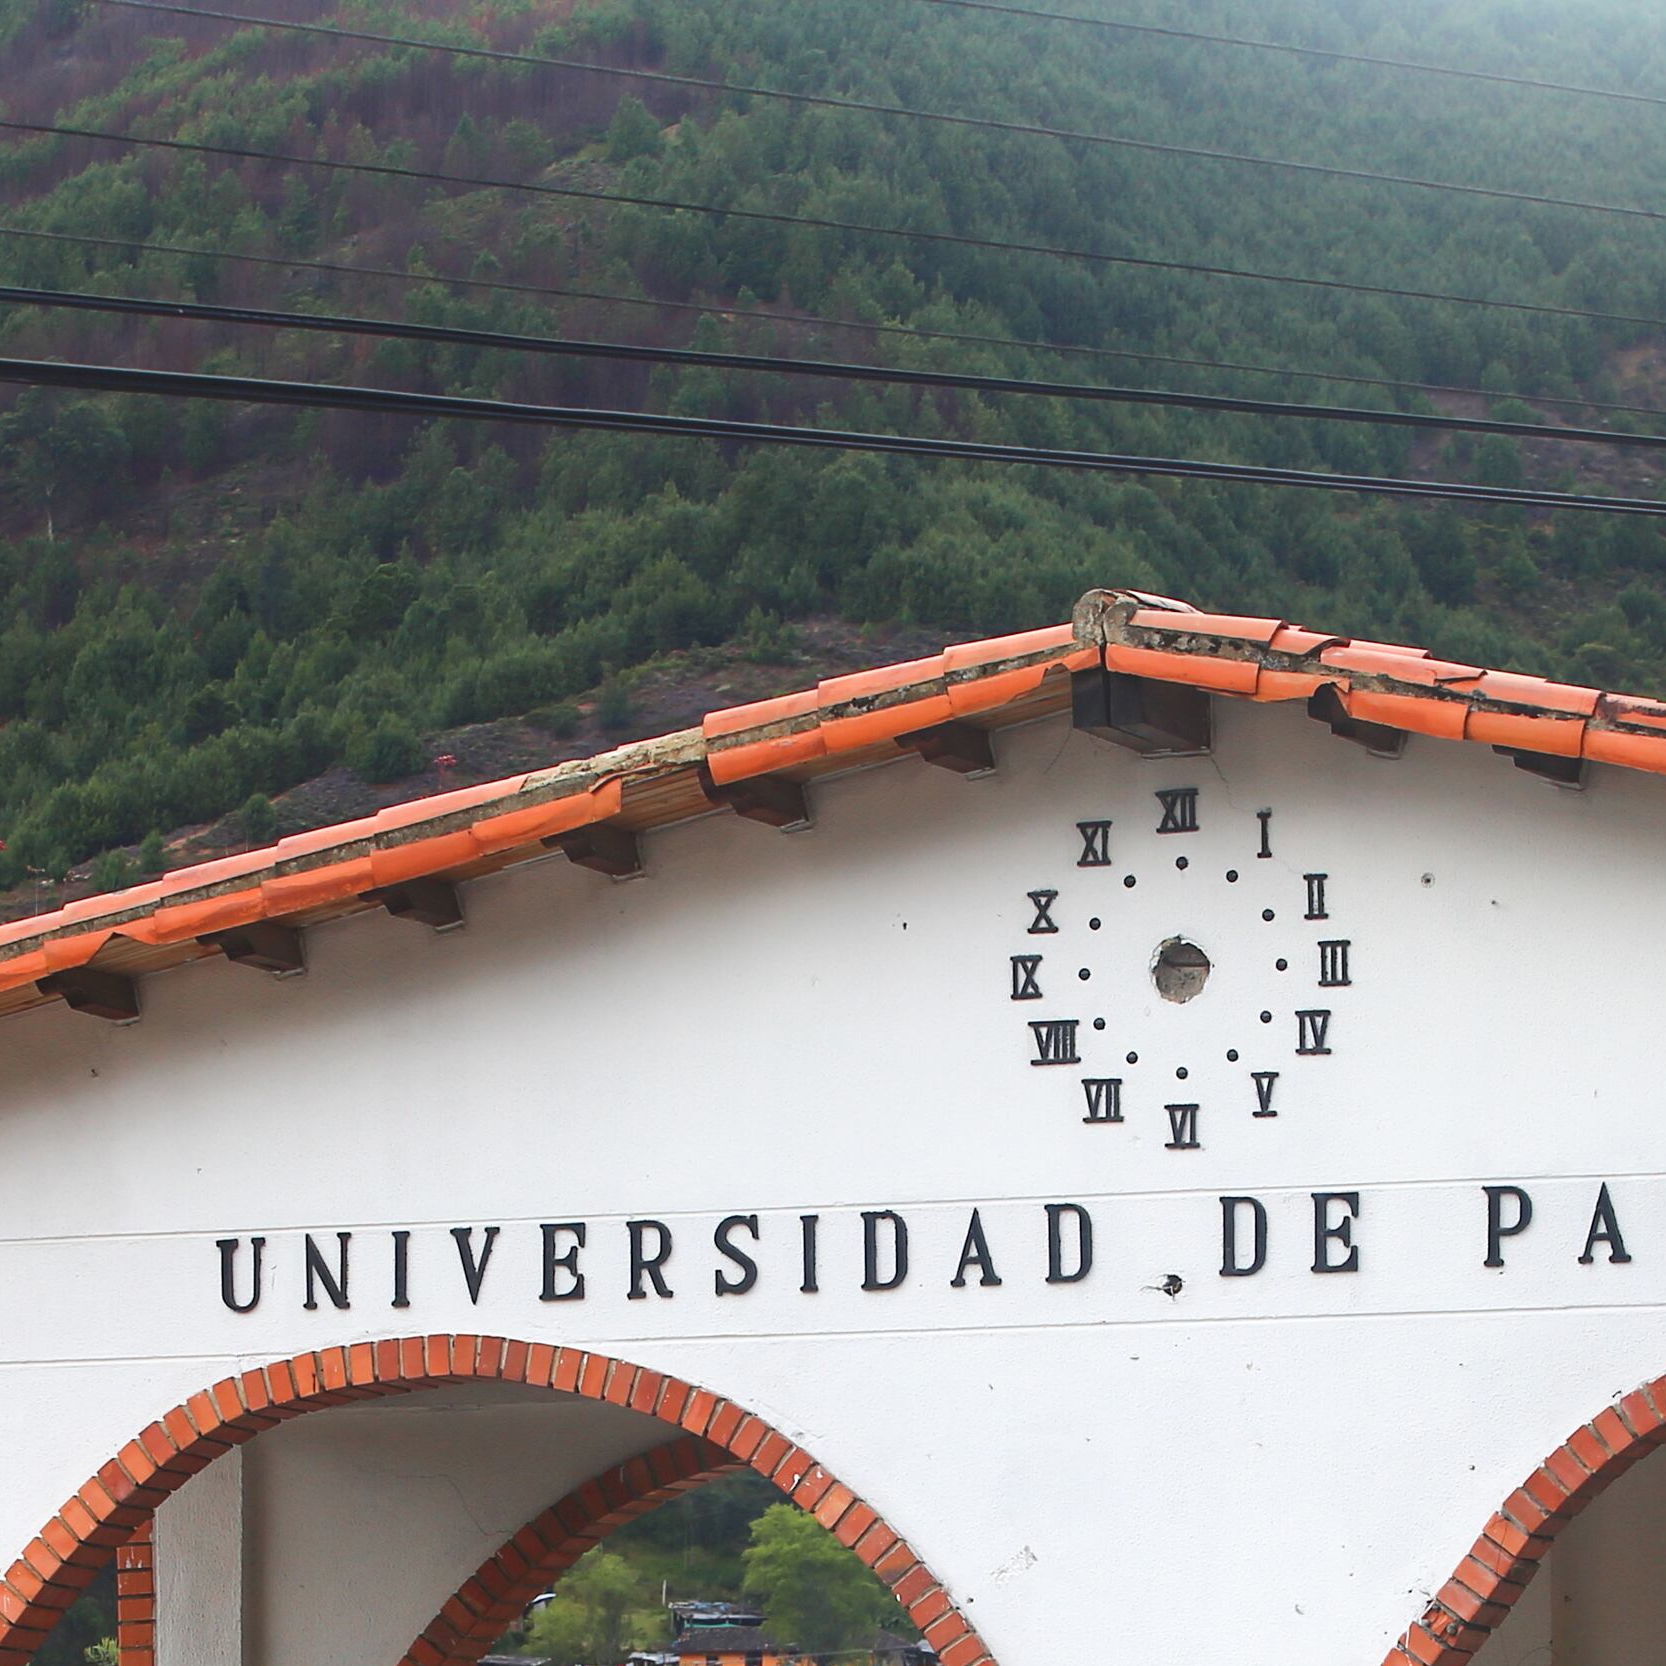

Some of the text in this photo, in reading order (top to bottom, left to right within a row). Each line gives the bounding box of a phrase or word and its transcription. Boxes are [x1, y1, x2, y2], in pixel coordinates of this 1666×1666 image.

[1154, 787, 1200, 834] XII
[1257, 807, 1272, 859] I
[1076, 820, 1113, 867] XI
[1026, 889, 1059, 934] X
[1302, 873, 1329, 920] II
[1010, 954, 1043, 1001] IX
[1317, 939, 1352, 987] III
[1027, 1019, 1082, 1066] VIII
[1294, 1009, 1332, 1055] IV
[1080, 1078, 1125, 1124] VII
[1250, 1071, 1280, 1118] V
[1163, 1103, 1201, 1150] VI
[215, 1202, 1094, 1314] UNIVERSIDAD
[1219, 1192, 1360, 1277] DE
